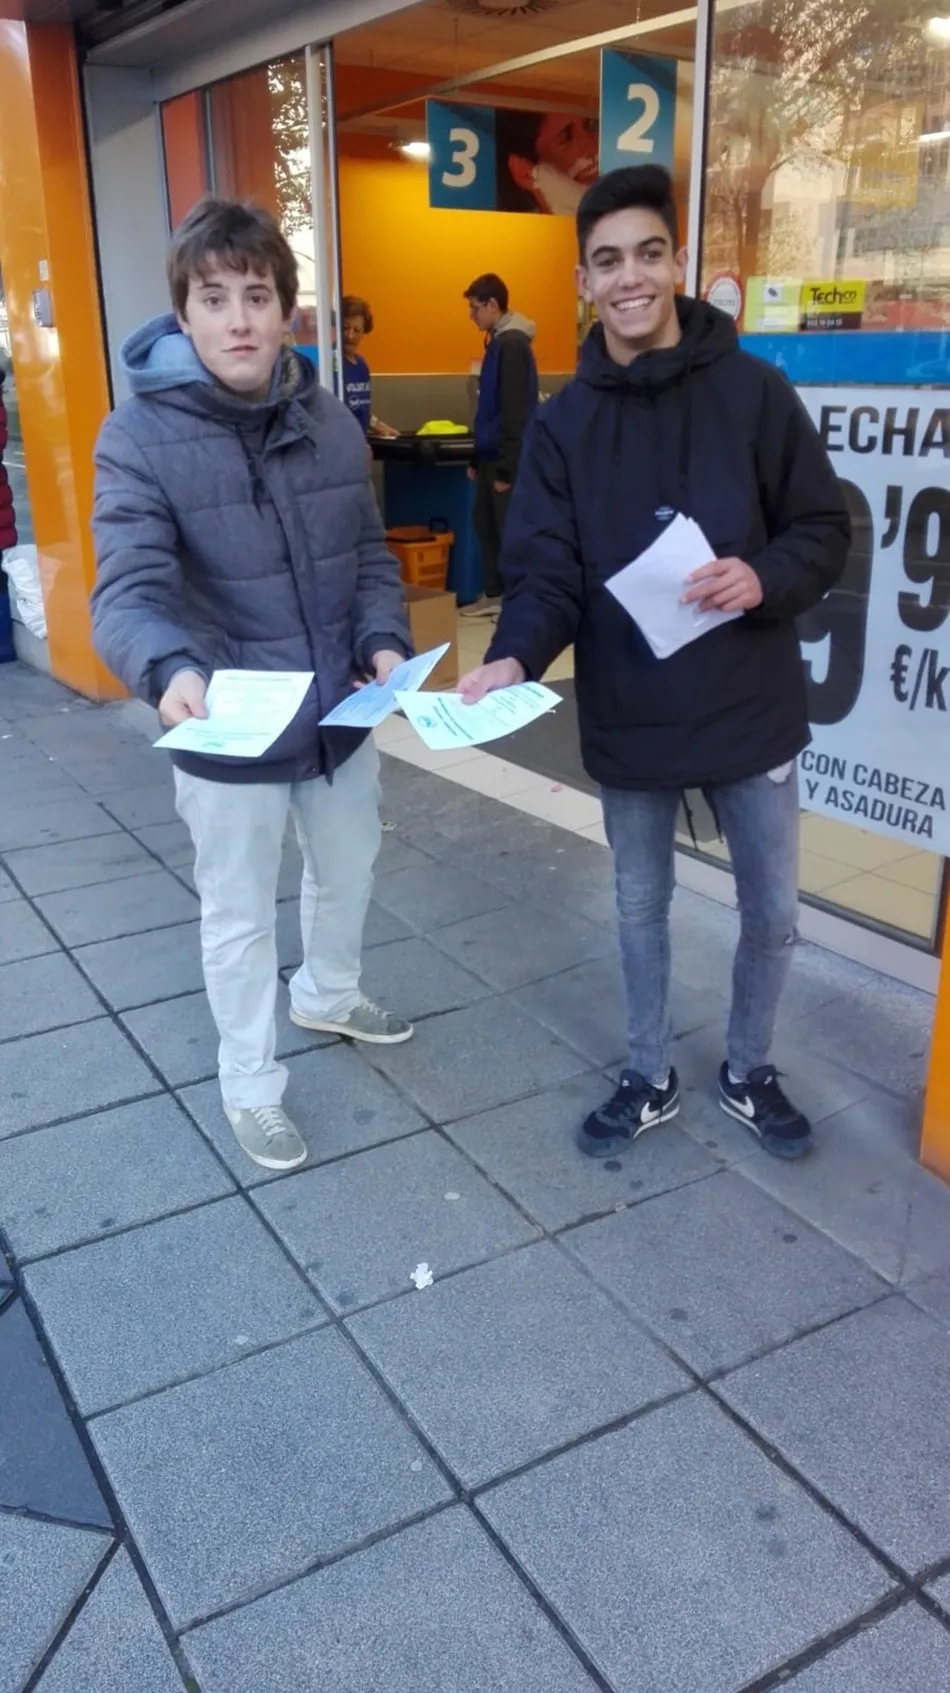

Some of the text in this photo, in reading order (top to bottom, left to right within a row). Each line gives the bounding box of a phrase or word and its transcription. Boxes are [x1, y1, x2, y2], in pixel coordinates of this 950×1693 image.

[617, 83, 660, 153] 2
[442, 128, 480, 188] 3
[801, 750, 946, 811] CON CABEZA
[805, 778, 934, 839] Y ASADURA
